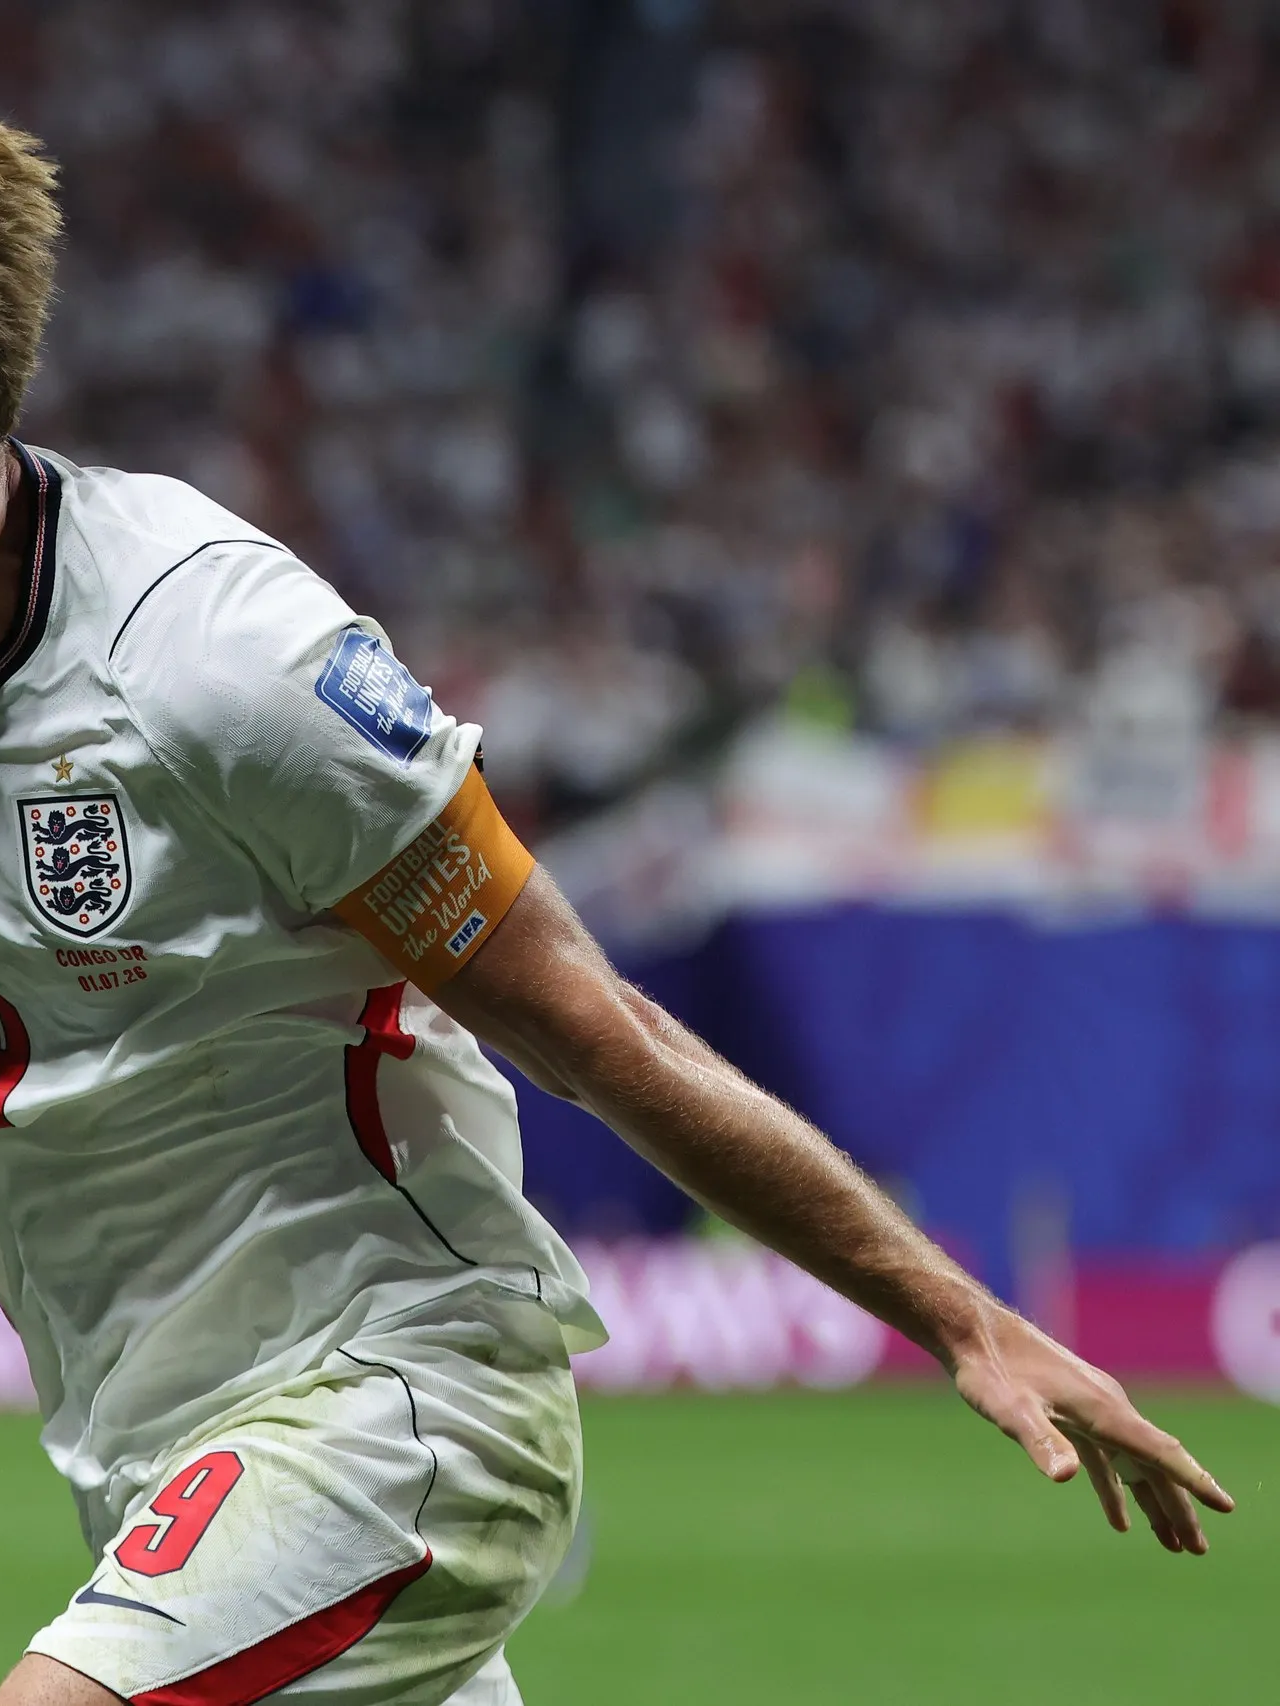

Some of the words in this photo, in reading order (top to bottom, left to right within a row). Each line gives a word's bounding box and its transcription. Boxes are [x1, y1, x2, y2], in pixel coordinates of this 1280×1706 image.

[354, 655, 393, 716] UNITES
[386, 670, 411, 715] World
[377, 710, 398, 736] the
[363, 819, 454, 914] FOOTBALL
[380, 833, 471, 936] UNITES
[402, 928, 438, 962] the
[431, 853, 492, 930] World
[449, 915, 484, 953] FIFA
[55, 948, 118, 967] CONGO
[117, 945, 148, 962] DR
[77, 965, 148, 992] 01.07.26
[114, 1450, 245, 1578] 9
